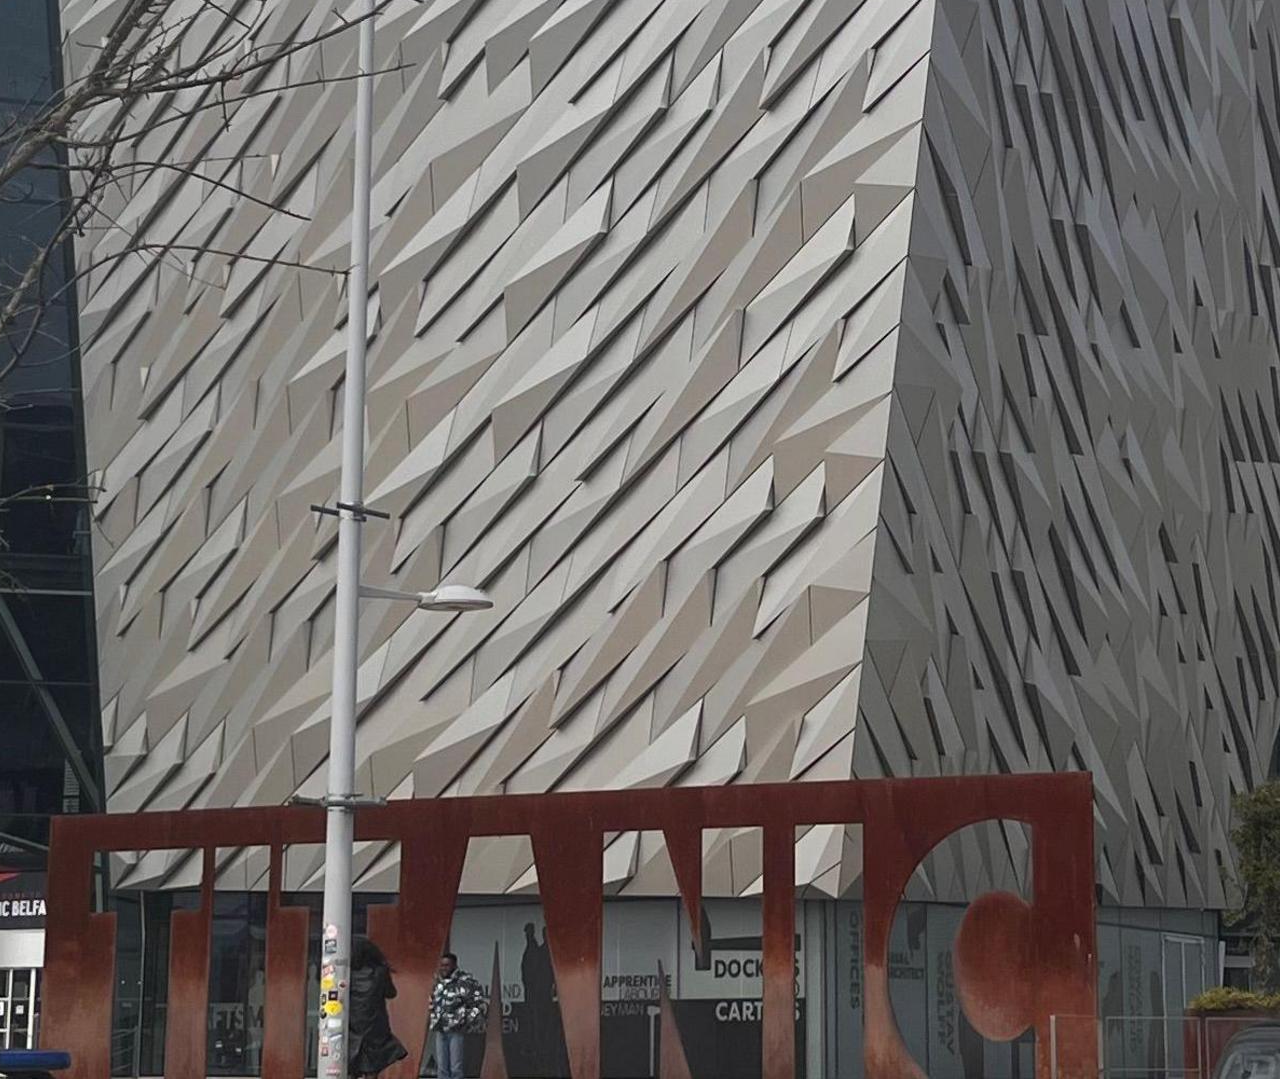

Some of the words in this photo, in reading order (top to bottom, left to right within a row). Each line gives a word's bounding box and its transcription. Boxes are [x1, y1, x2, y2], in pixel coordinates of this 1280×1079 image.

[12, 899, 47, 916] BELFA
[93, 819, 1034, 1079] TITANIC
[849, 910, 860, 1009] OFFICES
[603, 975, 672, 988] APPRENTIE
